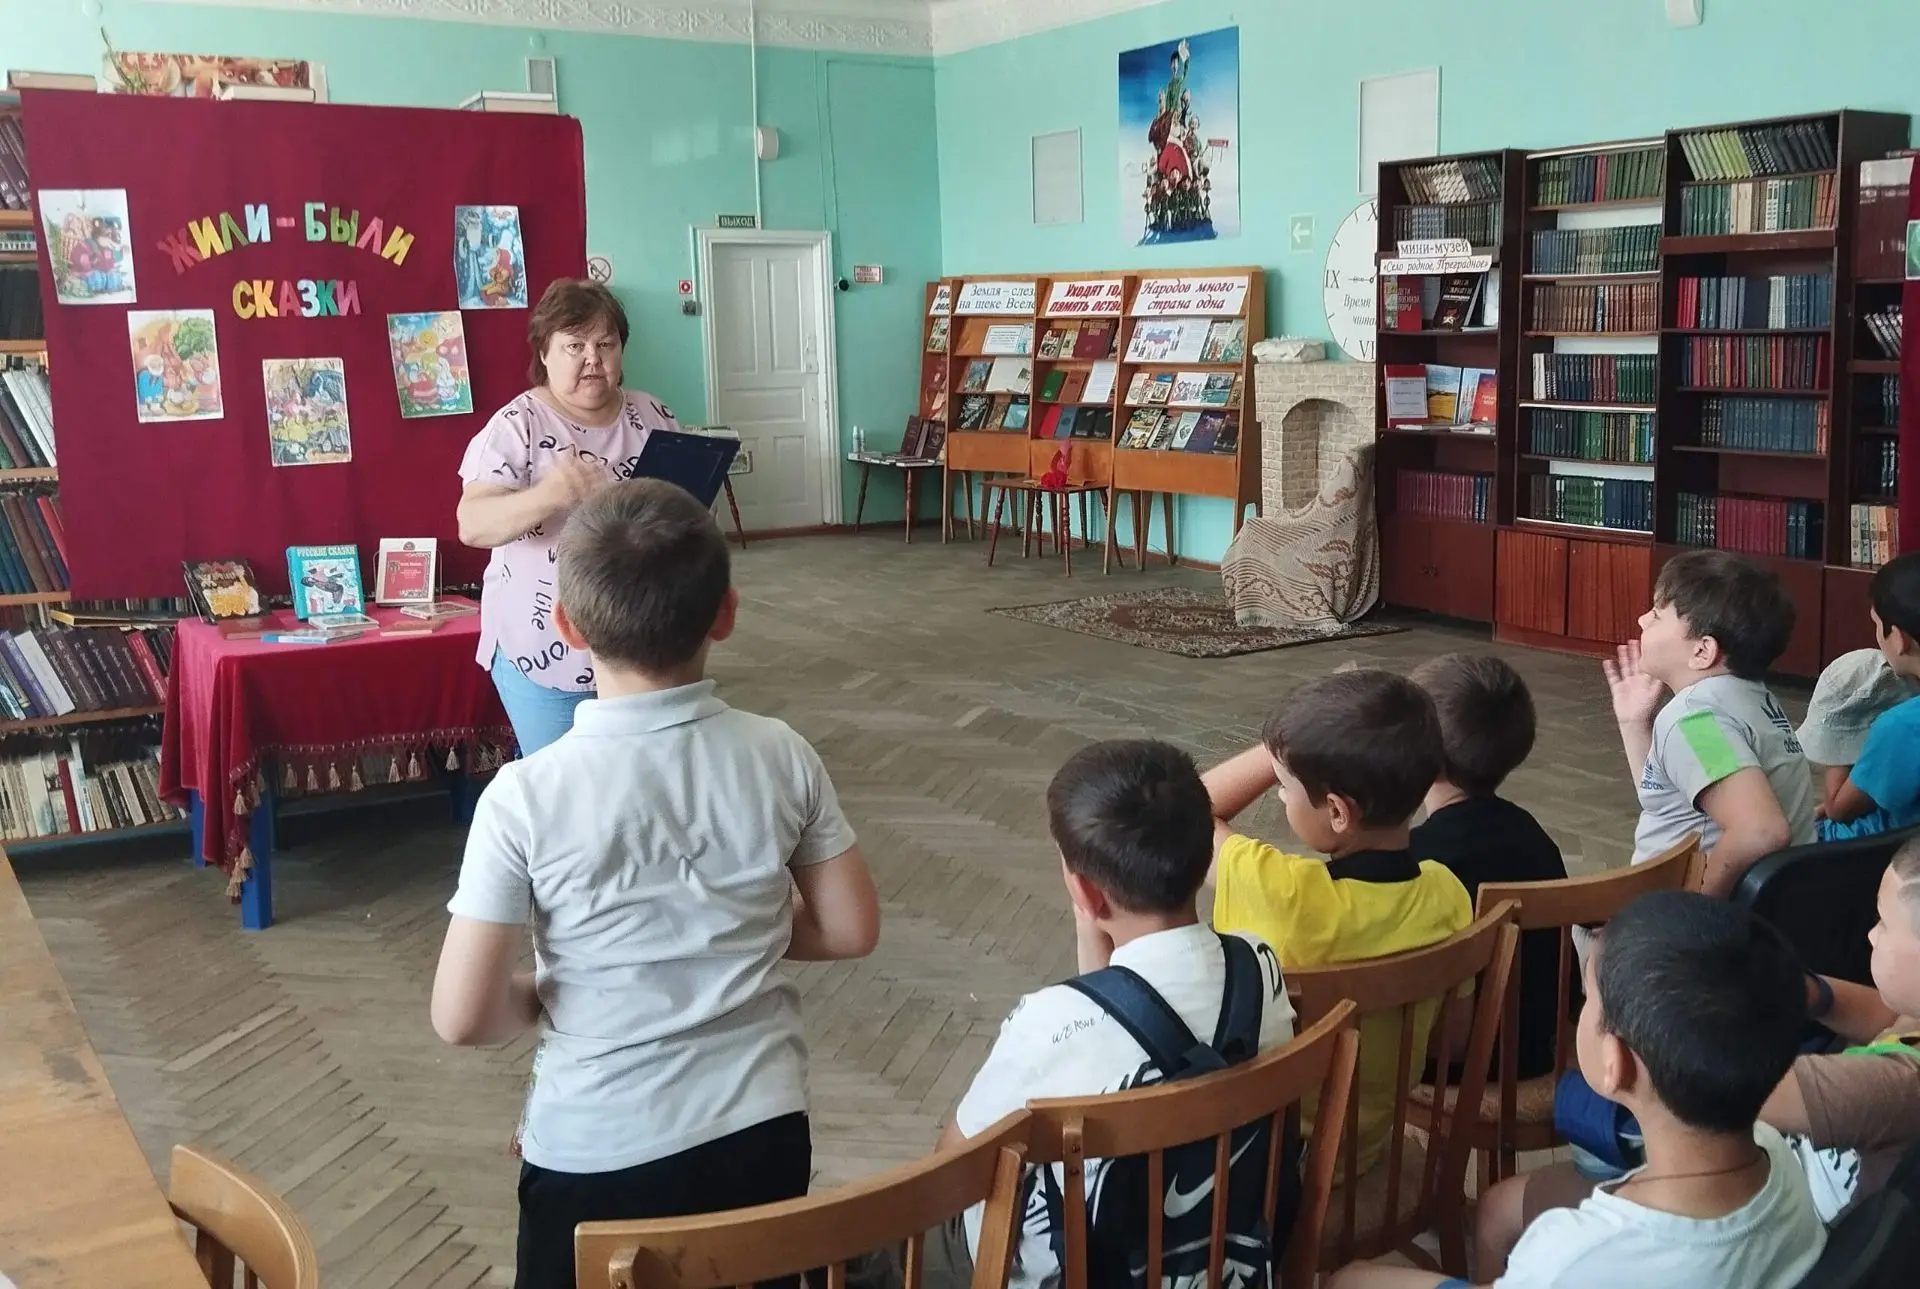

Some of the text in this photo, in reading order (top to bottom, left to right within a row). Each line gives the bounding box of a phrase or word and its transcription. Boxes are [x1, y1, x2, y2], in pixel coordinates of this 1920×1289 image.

[720, 216, 754, 227] ВЫХОД
[1400, 239, 1469, 257] мини-музей
[1141, 278, 1191, 298] Народов
[1195, 282, 1234, 293] много
[1325, 269, 1340, 289] IX
[232, 279, 362, 320] СКАЗКИ
[971, 284, 1002, 297] Земля
[1011, 287, 1036, 297] слез
[958, 300, 971, 309] на
[974, 300, 1002, 311] щеке
[1147, 294, 1226, 314] страна одна
[1343, 293, 1371, 311] Время
